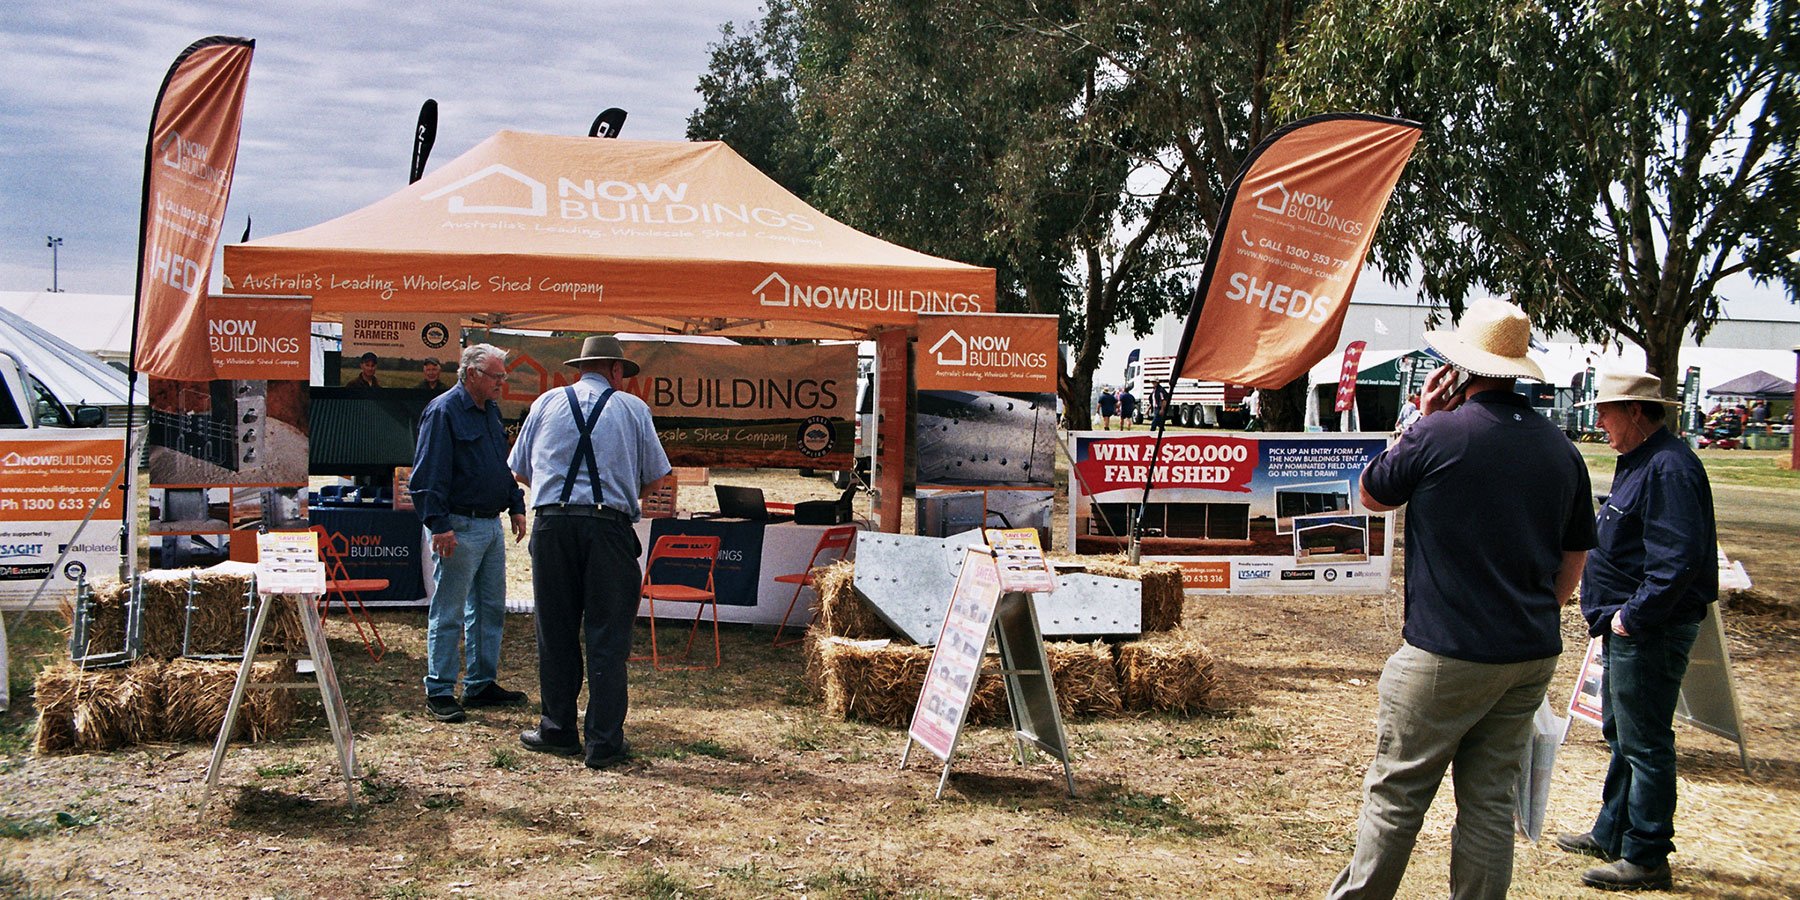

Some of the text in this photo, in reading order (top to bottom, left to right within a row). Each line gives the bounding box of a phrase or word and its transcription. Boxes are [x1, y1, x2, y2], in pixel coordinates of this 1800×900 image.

[181, 139, 208, 161] NOW
[558, 177, 688, 203] NOW
[1291, 191, 1333, 212] NOW
[559, 199, 815, 232] BUILDINGS
[1287, 203, 1363, 236] BUILDINGS
[611, 228, 694, 238] Wholesale
[701, 229, 747, 238] Shed
[755, 232, 823, 247] Company
[1258, 238, 1283, 252] CALL
[1286, 244, 1311, 260] 1300
[1312, 252, 1330, 266] 553
[153, 247, 200, 295] HED
[242, 273, 604, 302] Australia's Leading Wholesale Shed Company
[793, 285, 982, 314] NOWBUILDINGS
[1225, 271, 1332, 324] SHEDS
[209, 319, 257, 336] NOW
[354, 318, 416, 331] SUPPORTING
[353, 329, 400, 340] FARMERS
[969, 335, 1011, 351] NOW
[209, 336, 300, 354] BUILDINGS
[970, 352, 1047, 368] BUILDINGS
[554, 372, 838, 410] WBUILDINGS
[657, 427, 788, 448] esale Shed Company
[20, 455, 113, 466] NOWBUILDINGS
[1093, 443, 1248, 464] WIN A $20,000
[1104, 465, 1169, 483] FARM
[1, 498, 19, 510] Ph
[22, 498, 55, 510] 1300
[58, 498, 84, 510] 633
[0, 543, 118, 554] SAGHT allplates
[351, 535, 381, 546] NOW
[351, 546, 409, 558] BUILDINGS
[0, 566, 50, 576] DAEastland
[1238, 570, 1271, 579] LYSAGHT
